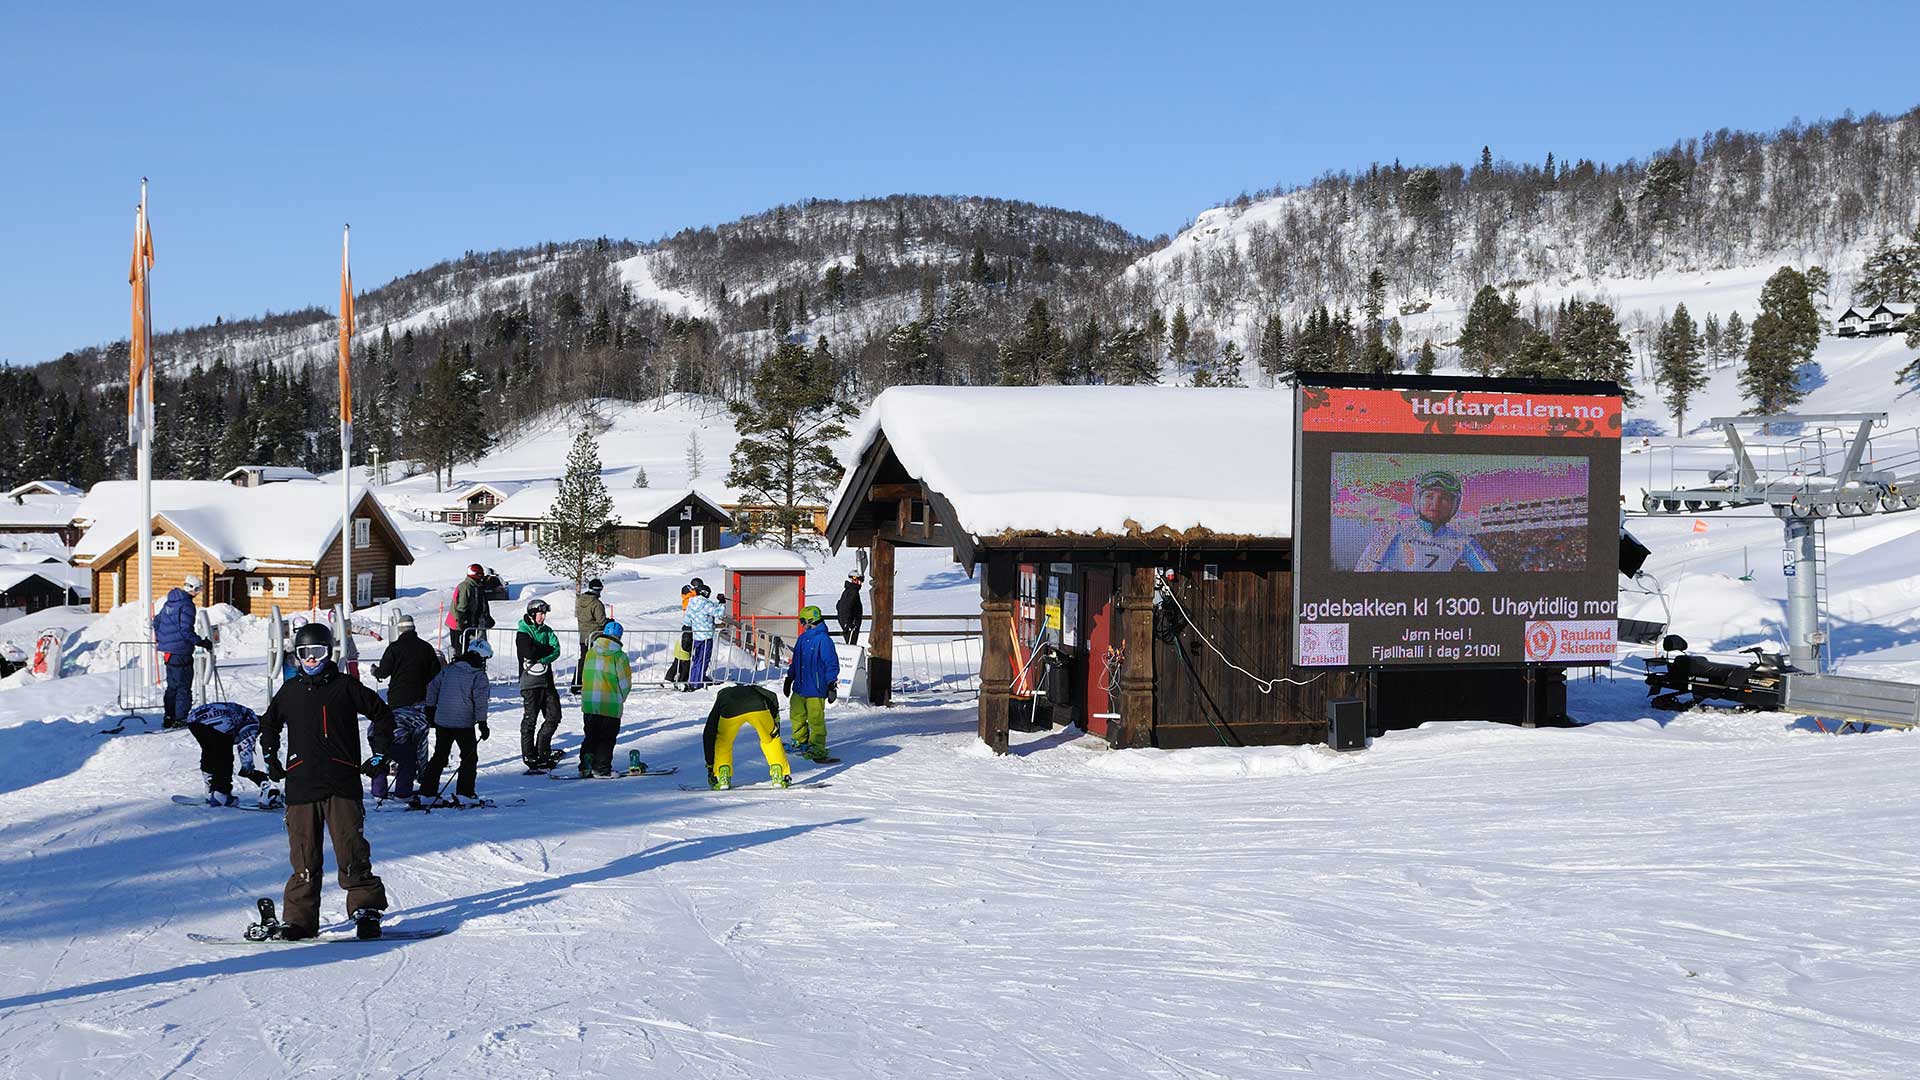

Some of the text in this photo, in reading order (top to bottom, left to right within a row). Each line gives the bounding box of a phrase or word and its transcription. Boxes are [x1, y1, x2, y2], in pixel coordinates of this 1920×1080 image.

[1411, 396, 1605, 419] Holtardalen.no
[1424, 553, 1440, 568] 7
[1413, 598, 1428, 616] kl
[1435, 597, 1485, 616] 1300.
[1492, 597, 1578, 619] Uhøytidlig
[1402, 628, 1430, 642] Jørn
[1434, 627, 1464, 641] Hoel
[1561, 628, 1611, 641] Rauland
[1372, 644, 1500, 661] Fjøllhalli i dag 2100!
[1560, 642, 1617, 654] Skisenter
